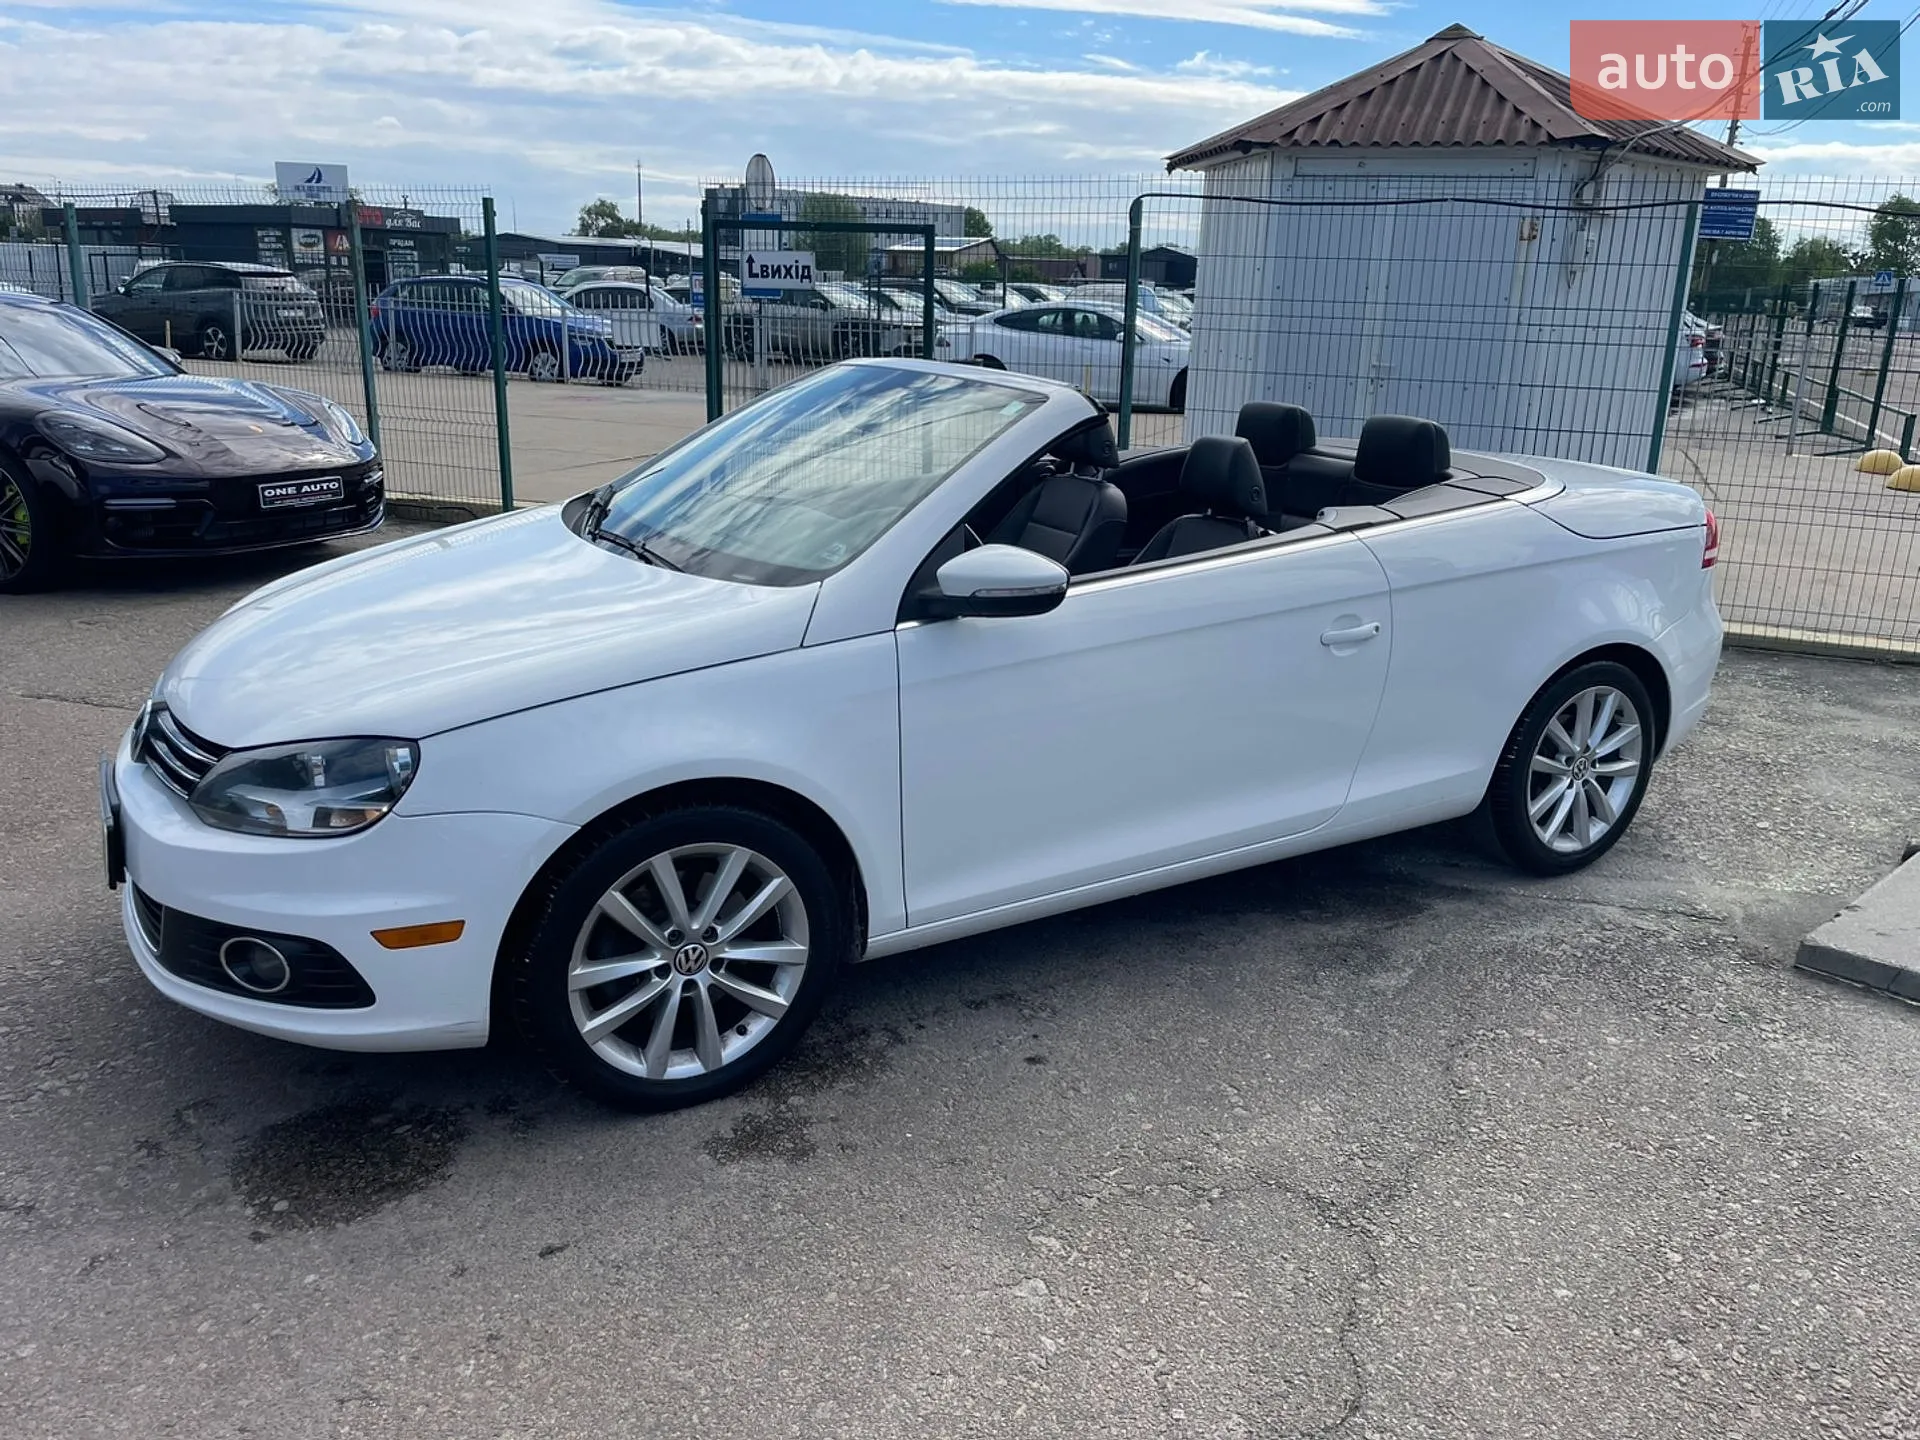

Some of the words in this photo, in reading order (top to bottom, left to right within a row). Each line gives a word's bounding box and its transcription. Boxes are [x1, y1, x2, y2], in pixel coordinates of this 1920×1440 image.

[760, 260, 812, 283] вихід
[264, 487, 297, 497] ONE
[301, 482, 339, 493] AUTO
